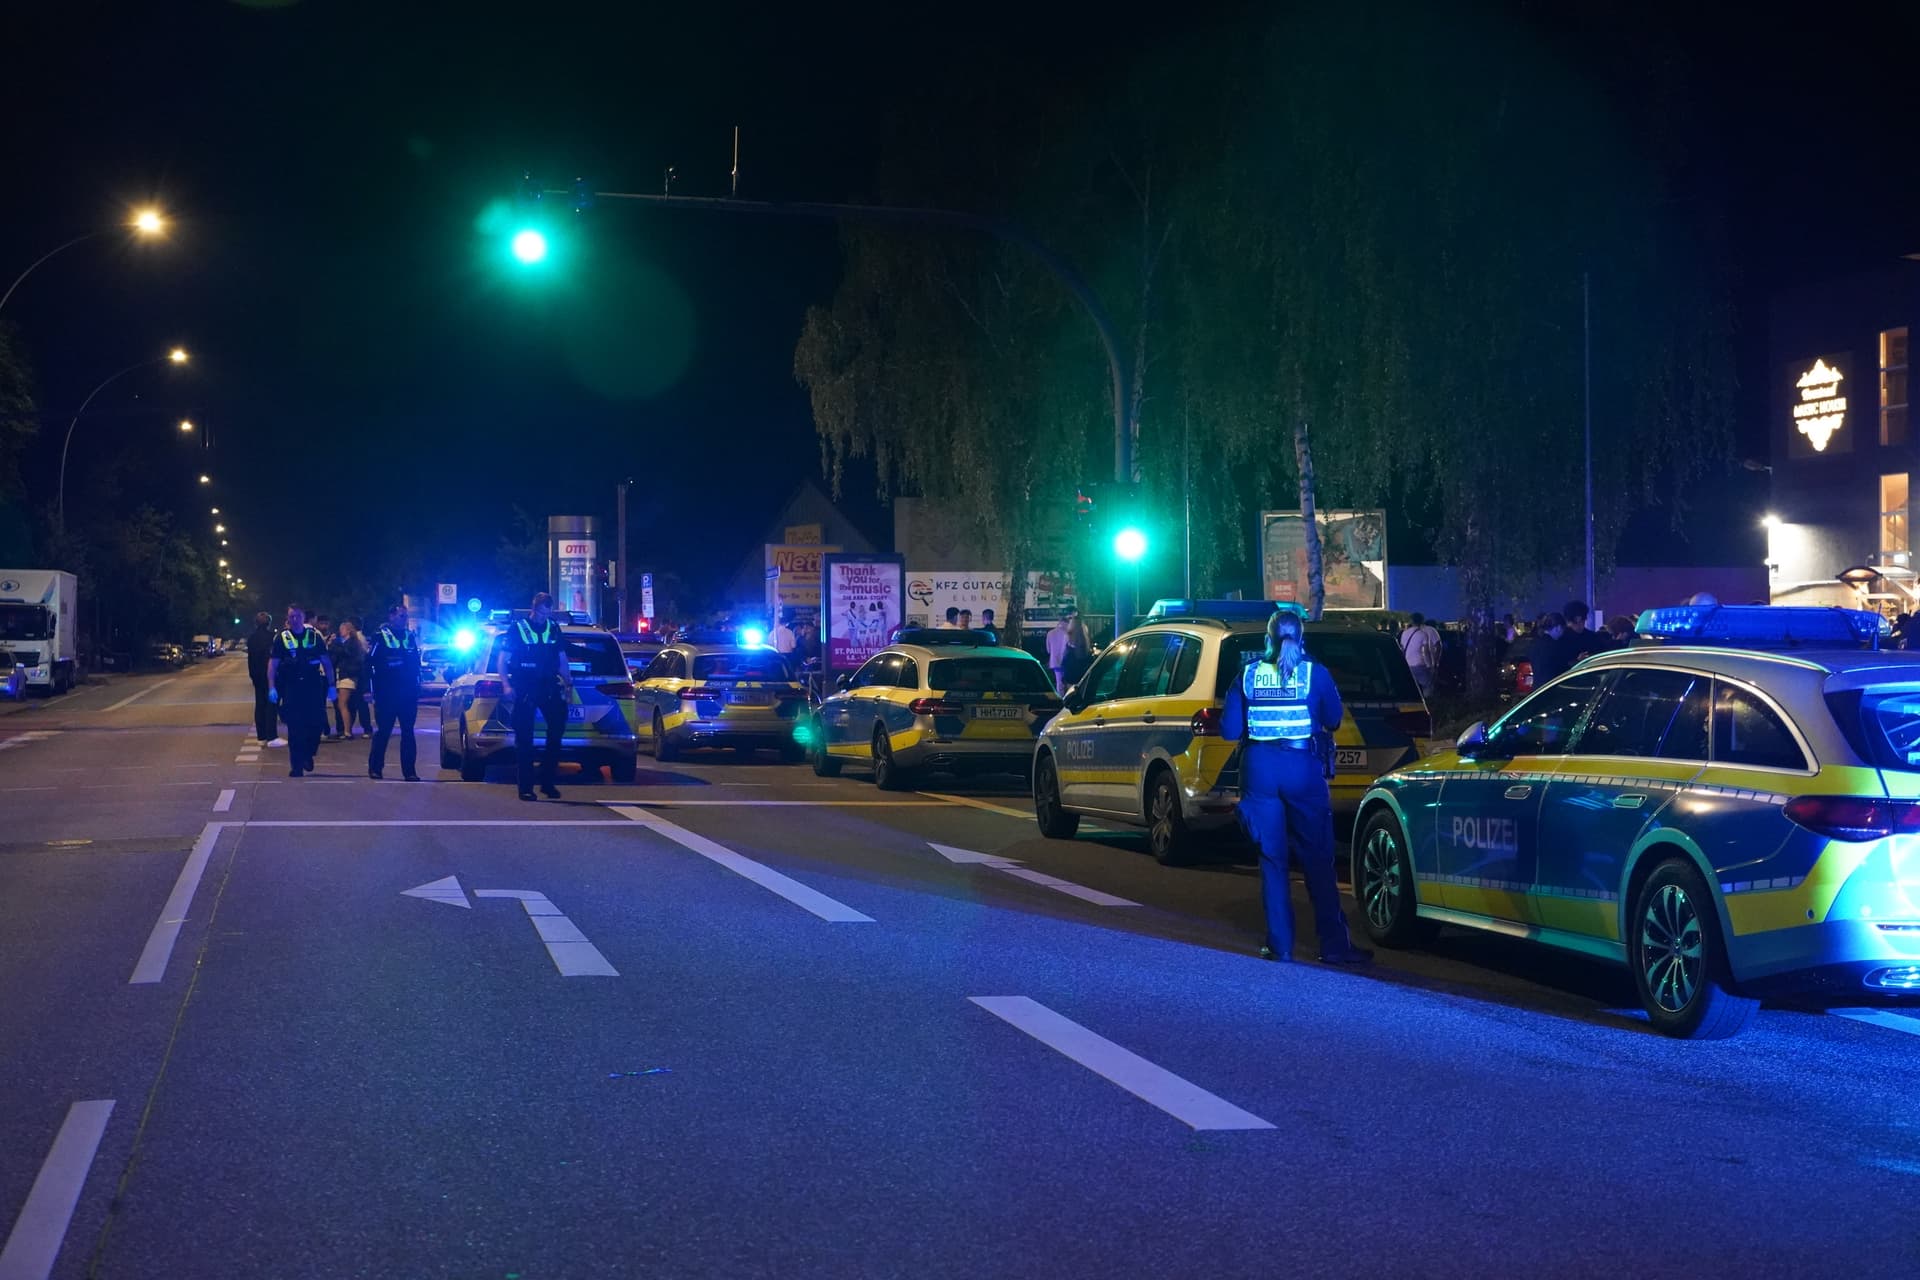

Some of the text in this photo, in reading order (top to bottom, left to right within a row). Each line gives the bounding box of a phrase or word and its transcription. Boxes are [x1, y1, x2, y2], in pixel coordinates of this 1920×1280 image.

[565, 545, 590, 554] OTTO
[776, 552, 822, 573] Nett
[840, 565, 877, 575] Thank
[847, 575, 868, 586] you
[936, 581, 959, 590] KFZ
[852, 583, 892, 594] music
[1067, 740, 1095, 760] POLIZEI
[1453, 816, 1518, 854] POLIZEI
